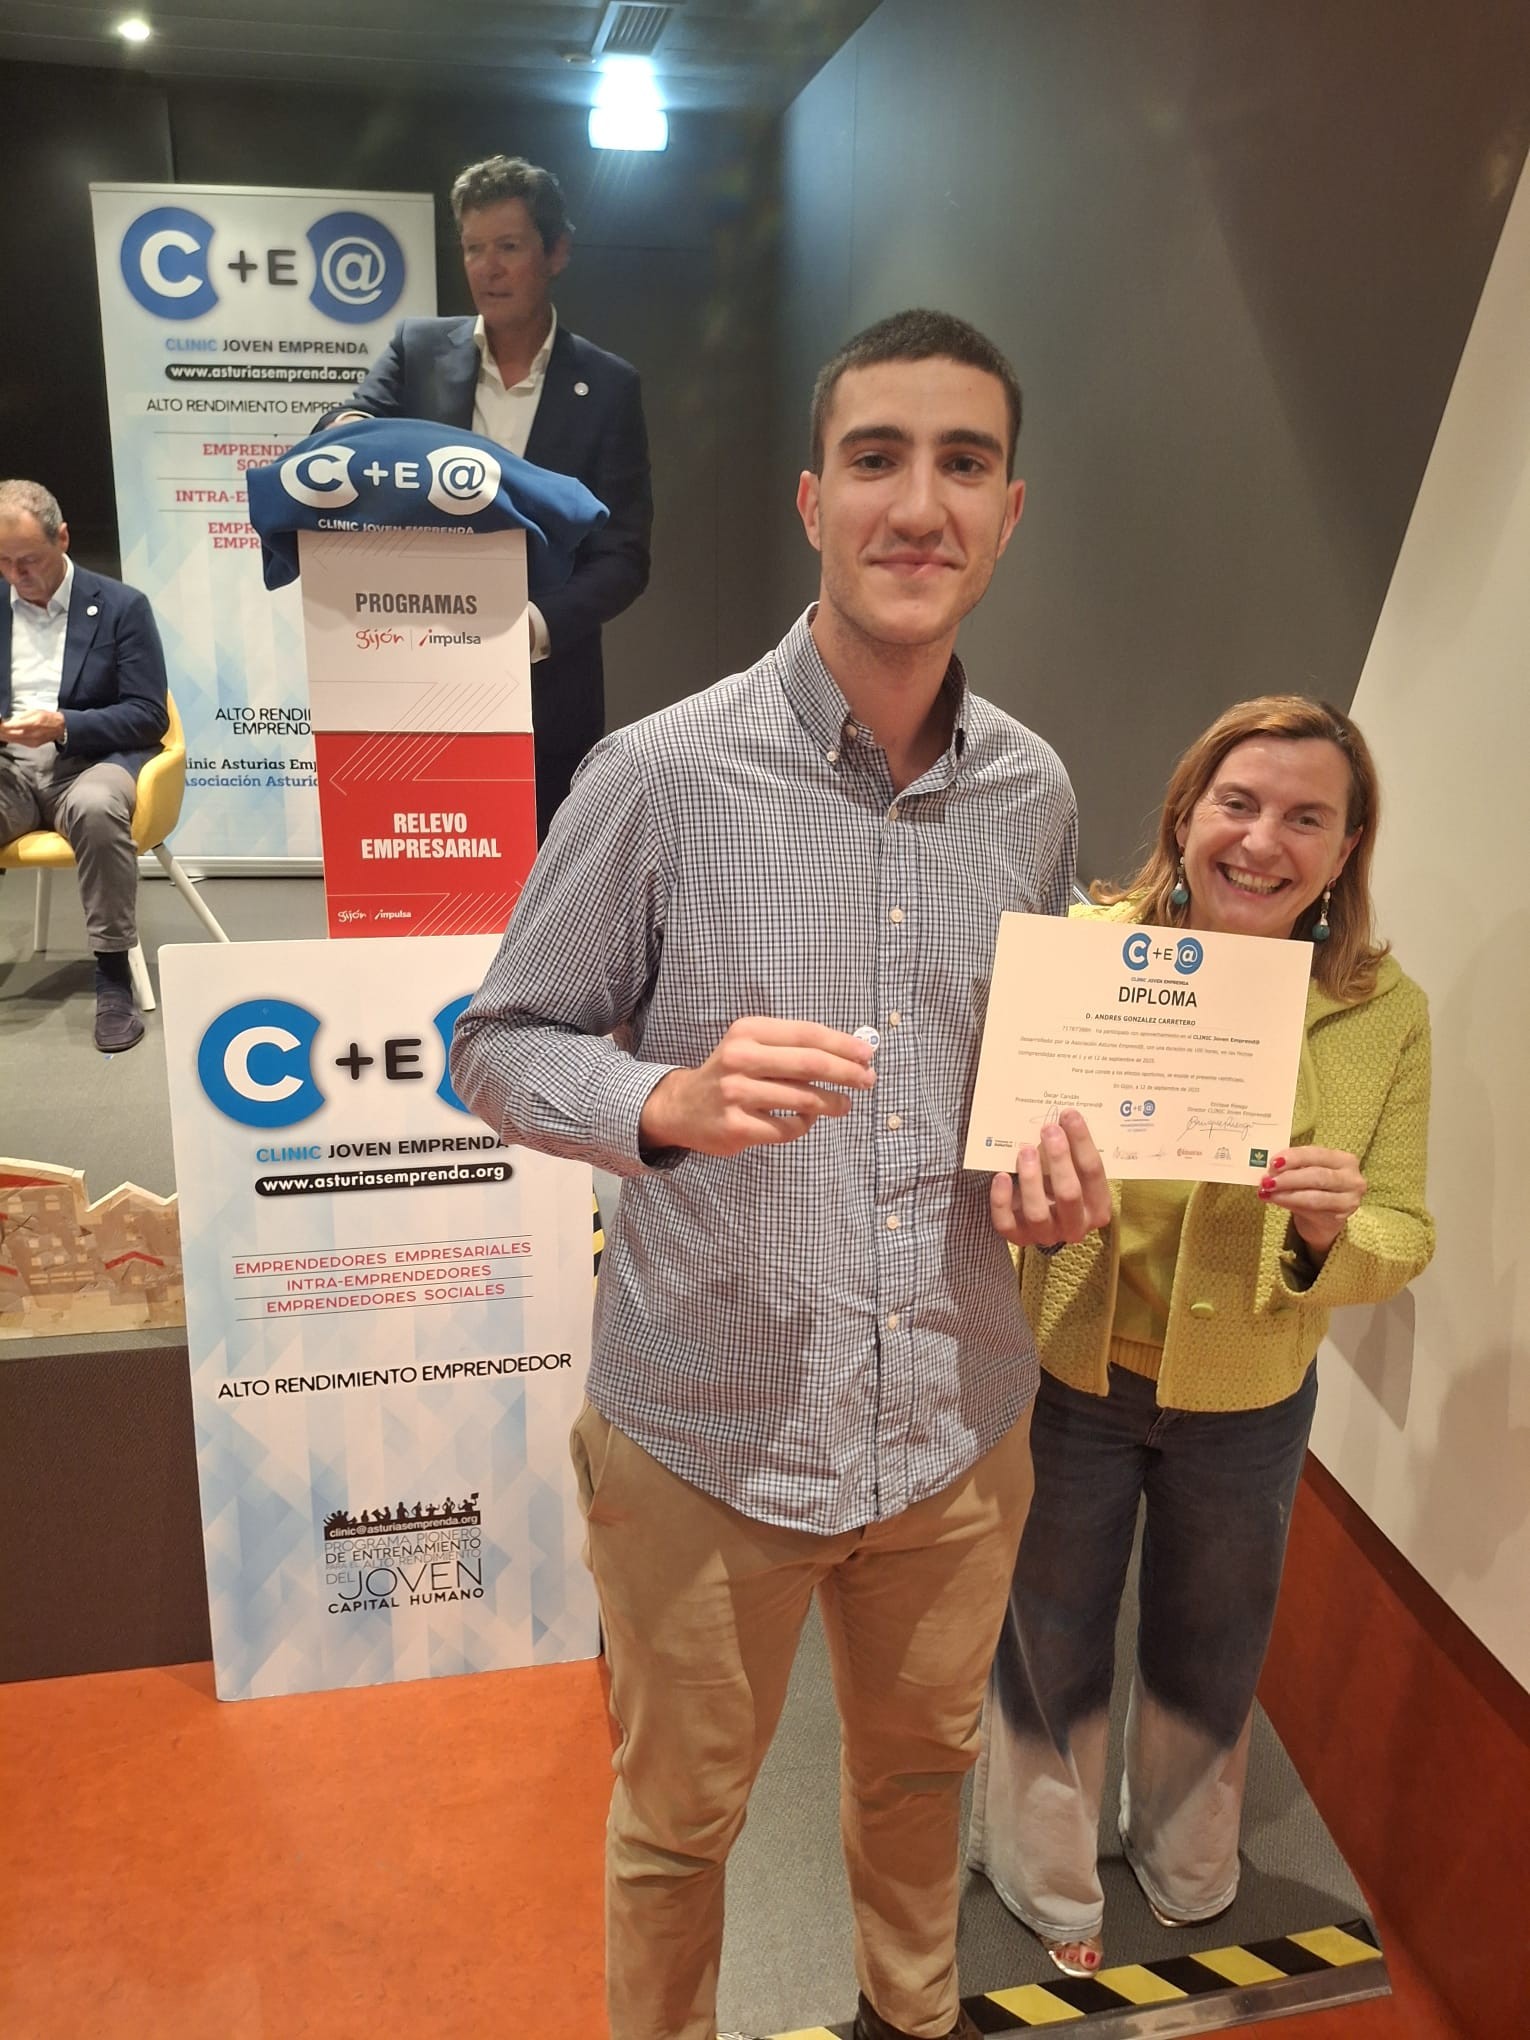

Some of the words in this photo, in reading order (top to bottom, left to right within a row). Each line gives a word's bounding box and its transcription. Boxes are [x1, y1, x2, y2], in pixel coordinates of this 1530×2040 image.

[165, 337, 218, 352] CLINIC
[222, 339, 273, 353] JOVEN
[278, 341, 369, 355] EMPRENDA
[170, 364, 366, 384] www.asturiasemprenda.org
[146, 398, 182, 413] ALTO
[186, 399, 287, 414] RENDIMIENTO
[317, 518, 360, 532] CLINIC
[355, 592, 478, 615] PROGRAMAS
[355, 628, 405, 650] gijón
[418, 628, 482, 647] impulsa
[215, 707, 256, 721] ALTO
[259, 707, 312, 721] RENDI
[221, 758, 286, 770] Asturias
[393, 812, 468, 834] RELEVO
[361, 838, 502, 859] EMPRESARIAL
[1118, 986, 1198, 1007] DIPLOMA
[1158, 1017, 1196, 1026] CARRETERO
[255, 1145, 322, 1164] CLINIC
[327, 1141, 391, 1160] JOVEN
[262, 1164, 505, 1192] www.asturiasemprenda.org
[235, 1253, 387, 1275] EMPRENDEDORES
[394, 1241, 532, 1263] EMPRESARIALES
[287, 1265, 492, 1291] INTRA-EMPRENDEDORES
[266, 1290, 417, 1314] EMPRENDEDORES
[424, 1283, 506, 1301] SOCIALES
[217, 1380, 270, 1399] ALTO
[275, 1366, 418, 1394] RENDIMIENTO
[422, 1353, 572, 1381] EMPRENDEDOR
[329, 1513, 478, 1538] clinic@asturiasemprenda.org
[325, 1535, 408, 1553] PROGRAMA
[416, 1527, 481, 1542] PIONERO
[326, 1553, 346, 1564] DE
[353, 1538, 481, 1562] ENTRENAMIENTO
[400, 1550, 481, 1565] RENDIMIENTO
[326, 1571, 356, 1584] DEL
[338, 1558, 483, 1600] JOVEN
[328, 1597, 400, 1614] CAPITAL
[410, 1587, 484, 1605] HUMANO
